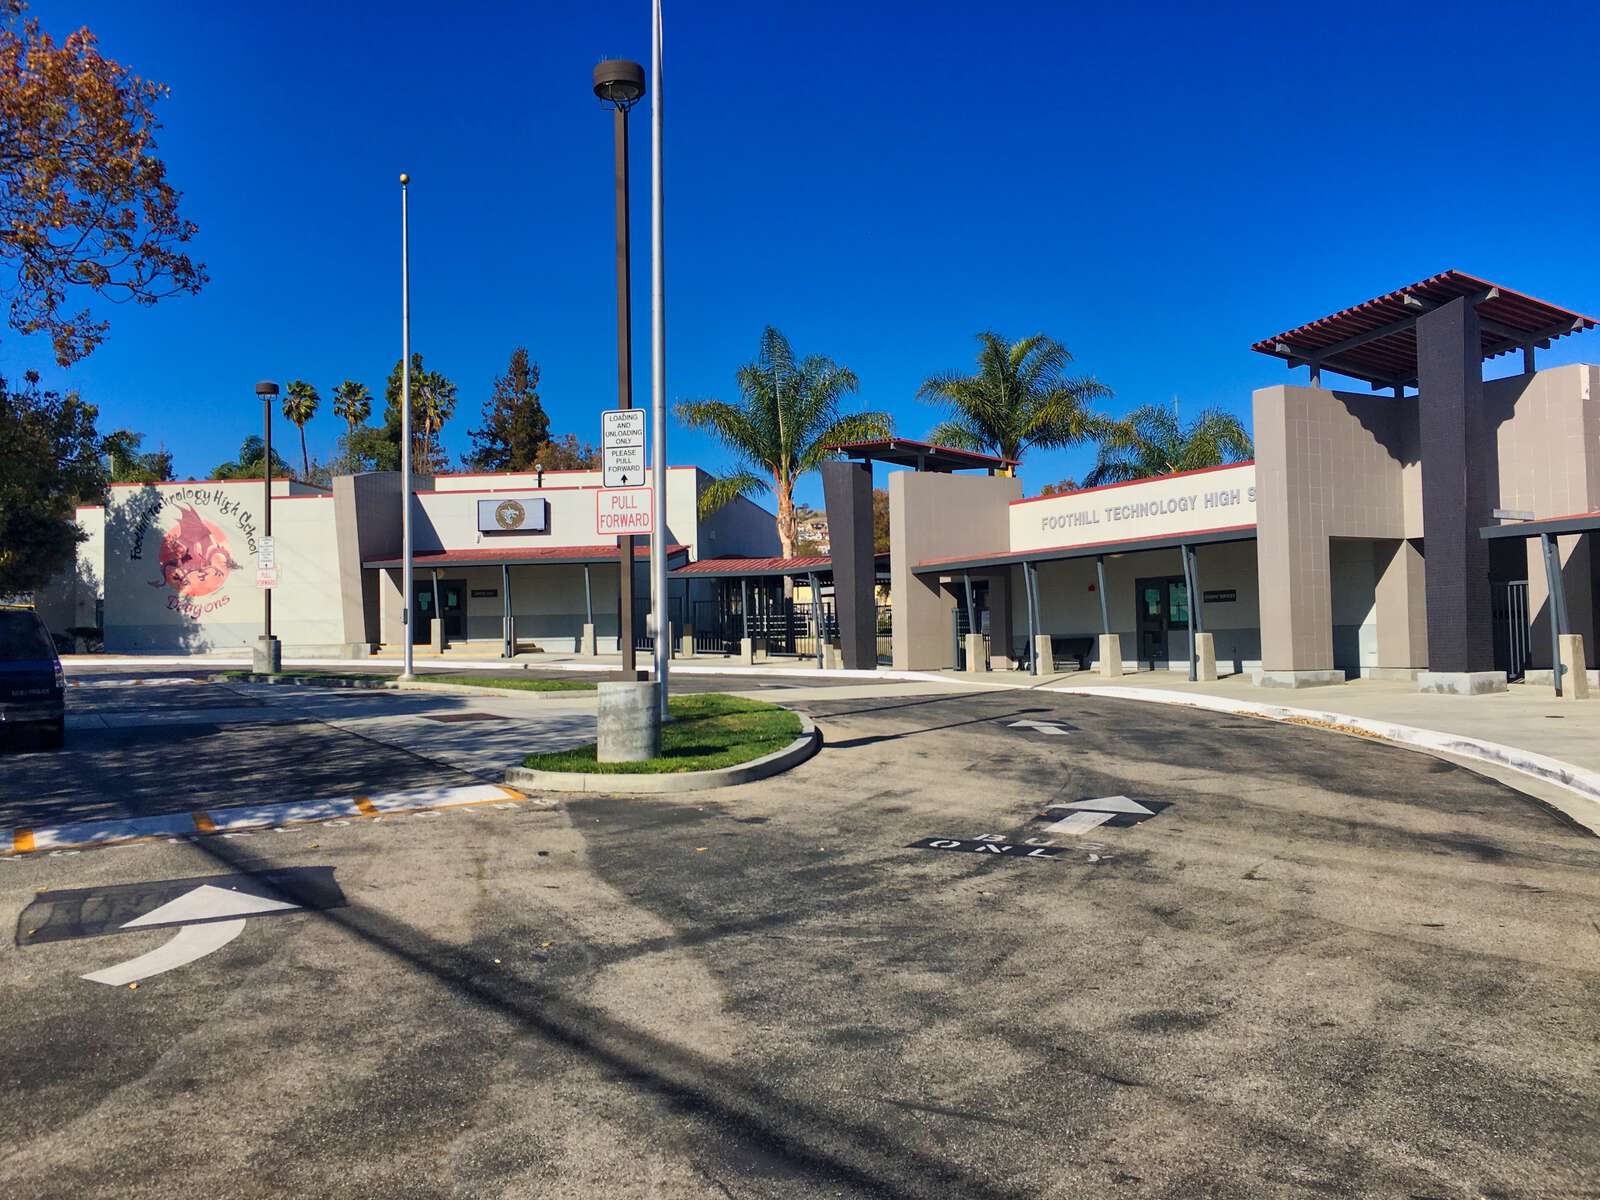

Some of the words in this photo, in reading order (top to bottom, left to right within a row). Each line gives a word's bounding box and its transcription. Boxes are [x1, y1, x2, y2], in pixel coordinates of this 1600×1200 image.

[609, 413, 638, 422] LOADING
[605, 429, 642, 438] UNLOADING
[611, 449, 636, 457] PLEASE
[608, 465, 640, 473] FORWARD
[611, 495, 638, 510] PULL
[1041, 510, 1100, 531] FOOTHILL
[1105, 494, 1198, 522] TECHNOLOGY
[1204, 488, 1240, 509] HIGH
[213, 489, 241, 516] High
[236, 511, 259, 555] School
[600, 512, 650, 529] FORWARD
[167, 595, 231, 619] Dragons
[973, 833, 1105, 850] BUS
[929, 840, 1114, 862] ONLY
